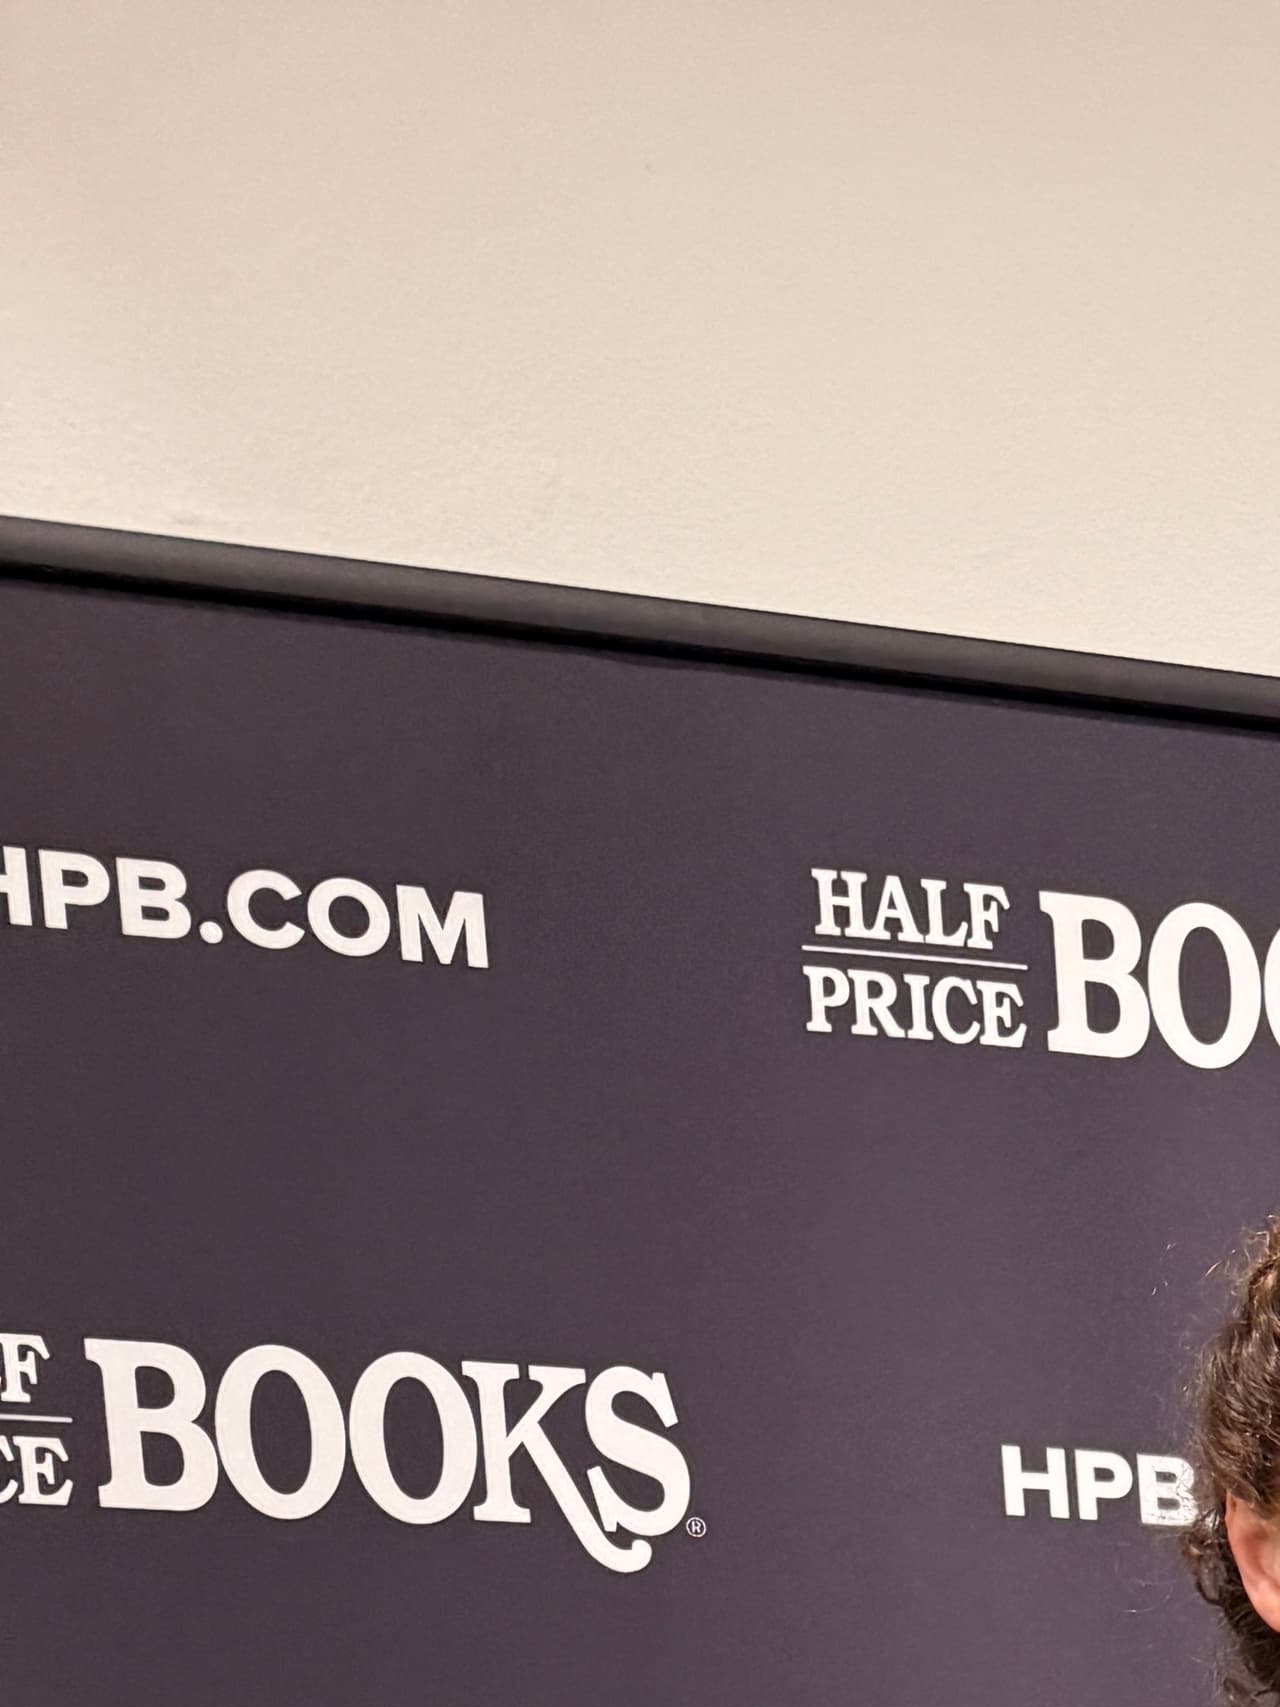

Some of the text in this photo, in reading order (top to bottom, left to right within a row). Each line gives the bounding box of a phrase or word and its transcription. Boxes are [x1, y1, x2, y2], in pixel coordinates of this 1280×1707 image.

[811, 868, 1010, 950] HALF
[803, 965, 1027, 1048] PRICE
[84, 1338, 693, 1573] BOOKS
